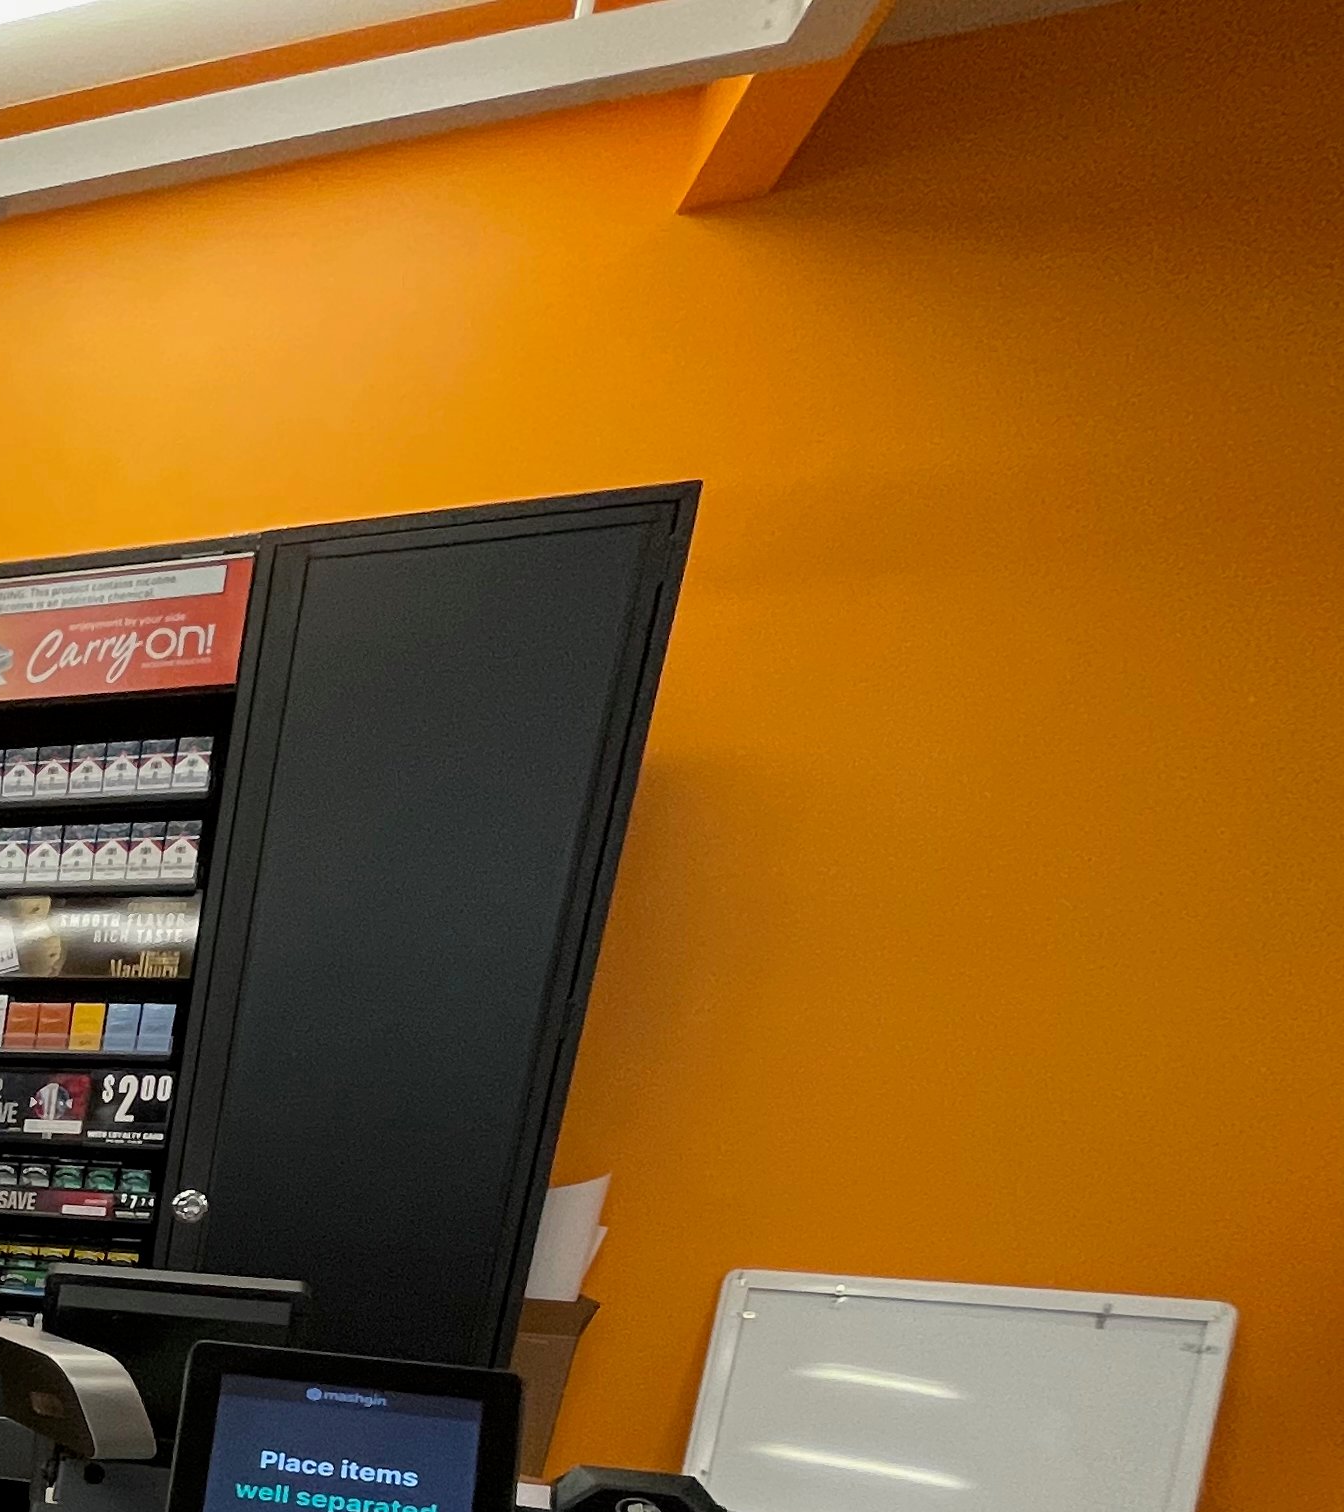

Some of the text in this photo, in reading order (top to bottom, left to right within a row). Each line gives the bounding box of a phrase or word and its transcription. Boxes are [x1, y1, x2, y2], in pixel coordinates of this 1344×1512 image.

[26, 628, 143, 685] Carry
[323, 1387, 388, 1408] mashgin
[259, 1448, 420, 1488] Place items
[234, 1480, 289, 1504] well
